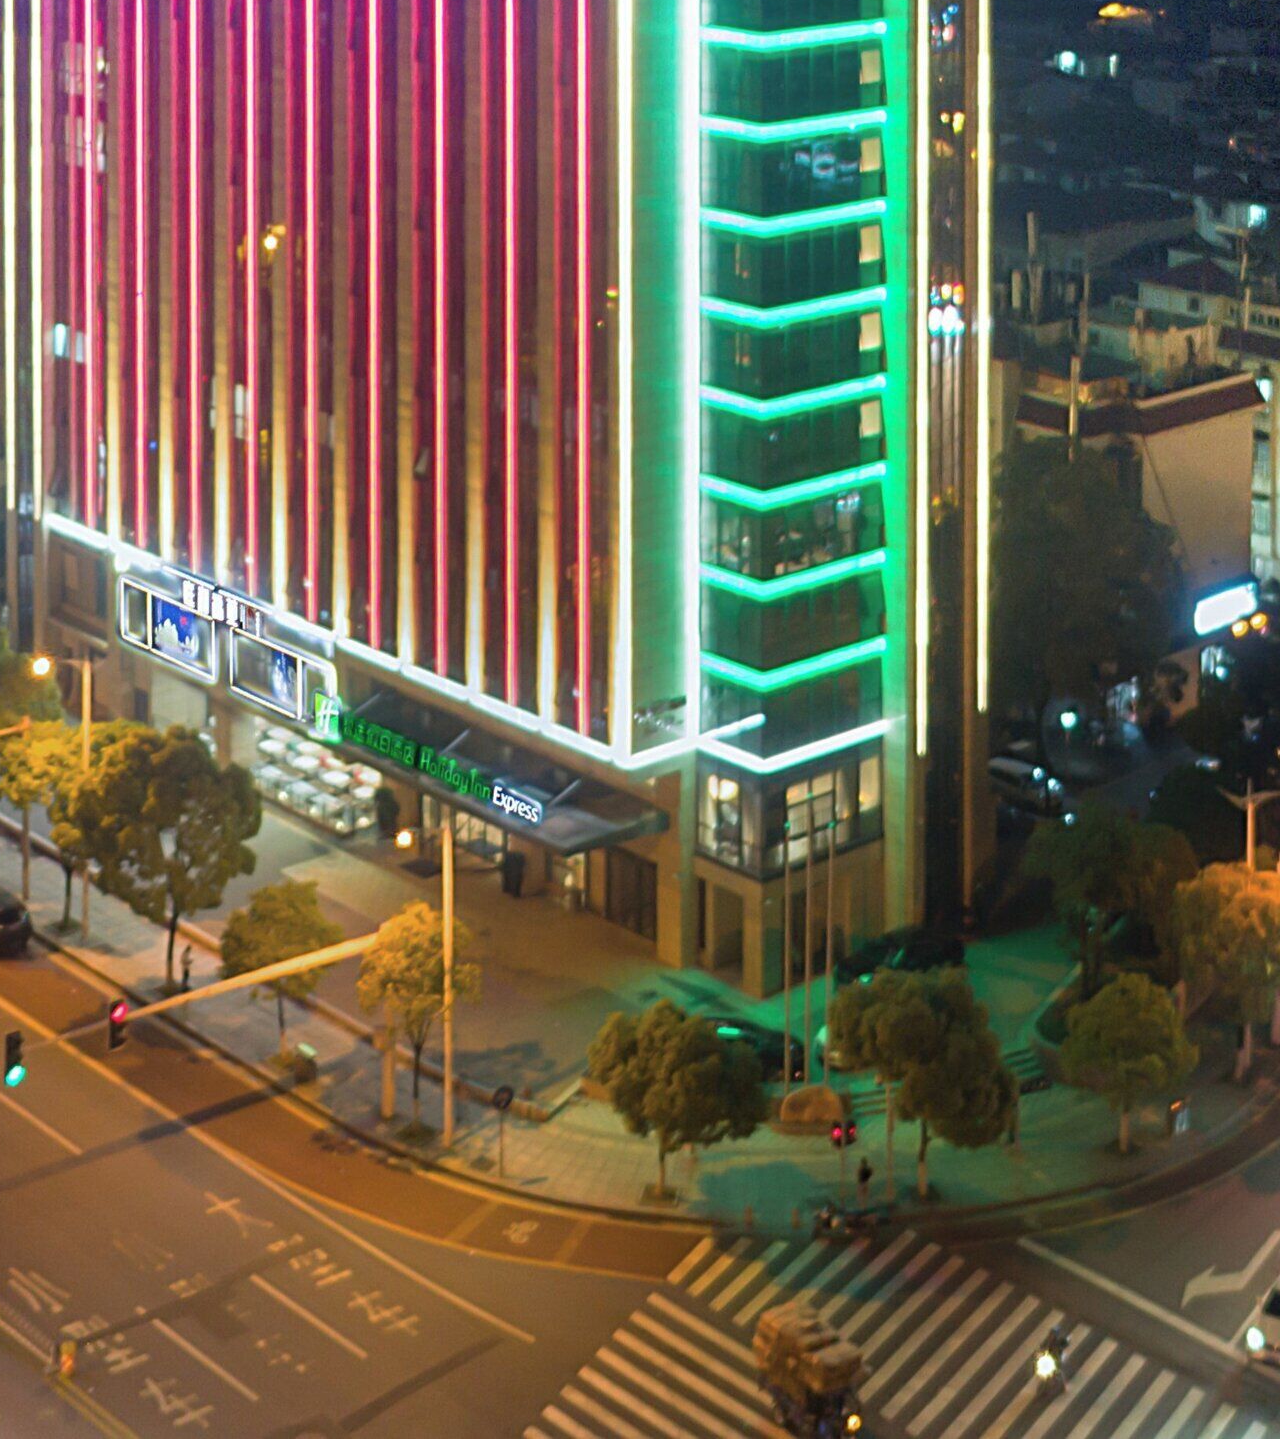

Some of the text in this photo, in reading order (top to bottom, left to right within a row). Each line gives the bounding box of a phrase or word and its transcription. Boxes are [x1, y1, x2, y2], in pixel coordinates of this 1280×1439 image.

[420, 750, 539, 823] Holiday Inn Express
